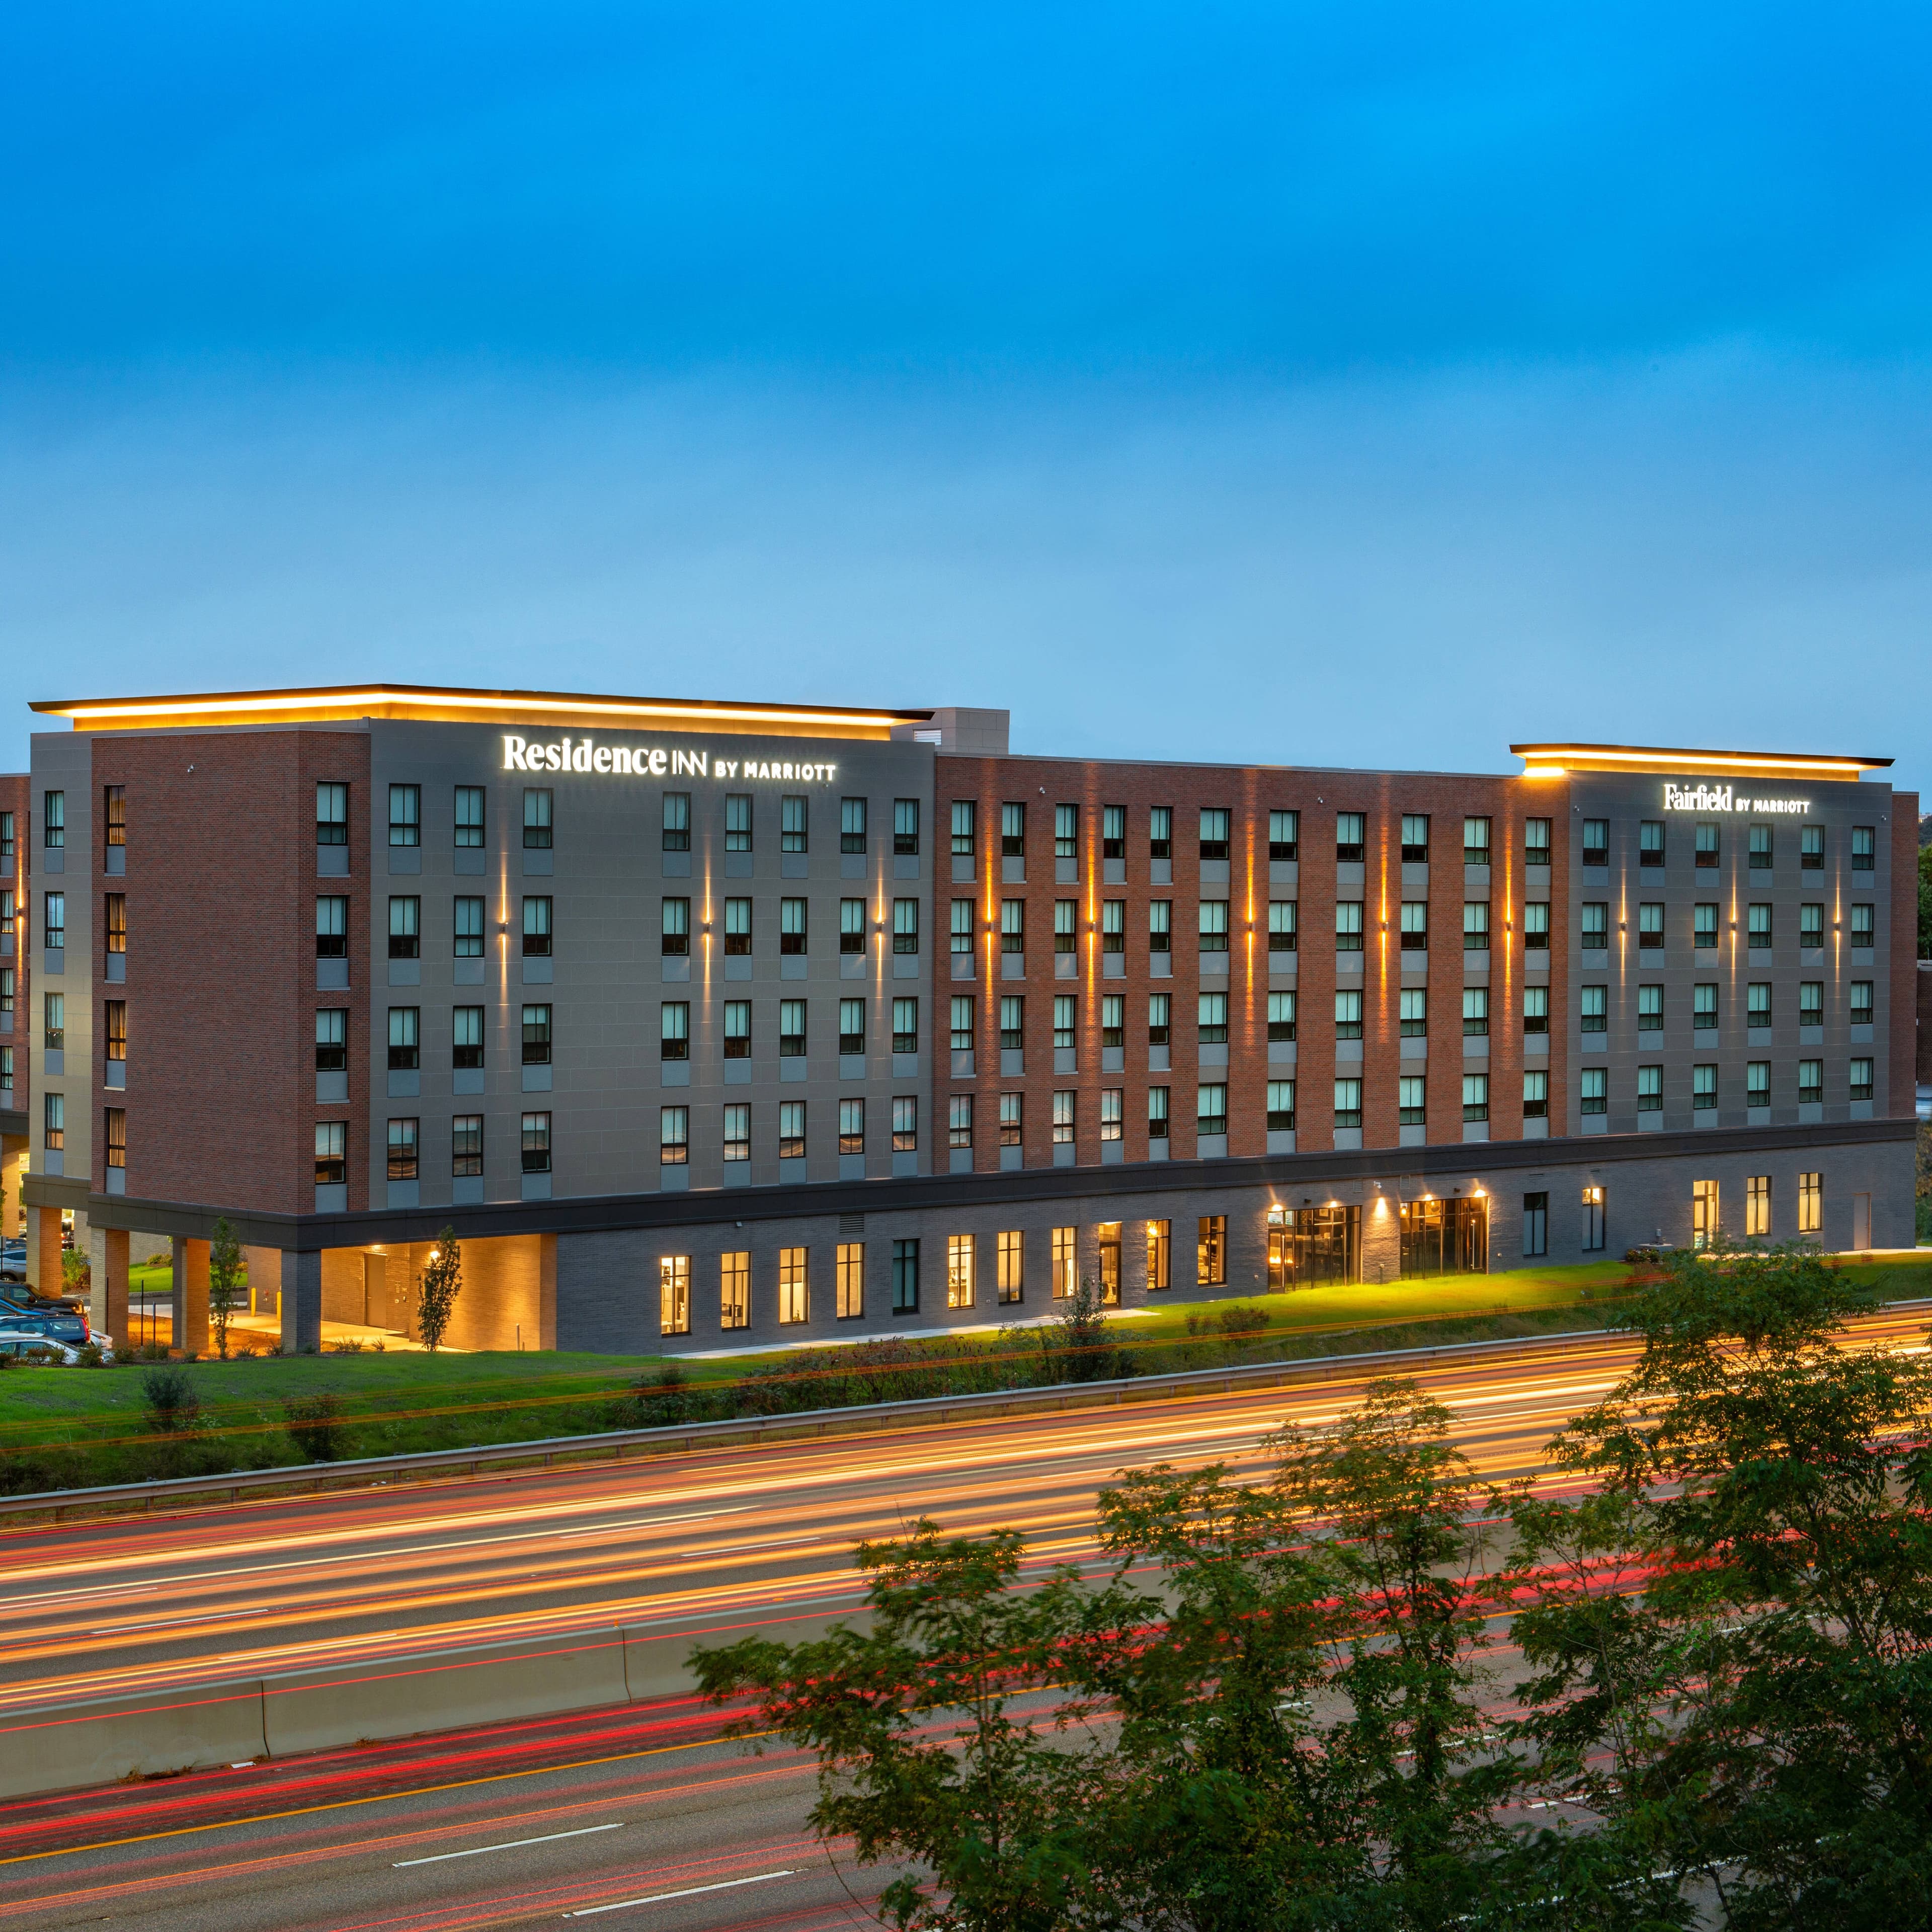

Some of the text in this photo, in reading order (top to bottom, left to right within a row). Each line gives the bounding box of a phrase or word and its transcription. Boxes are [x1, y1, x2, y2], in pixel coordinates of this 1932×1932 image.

[502, 736, 836, 780] Residence INN BY MARRIOTT
[1663, 783, 1810, 813] Fairfield BY MARRIOTT
